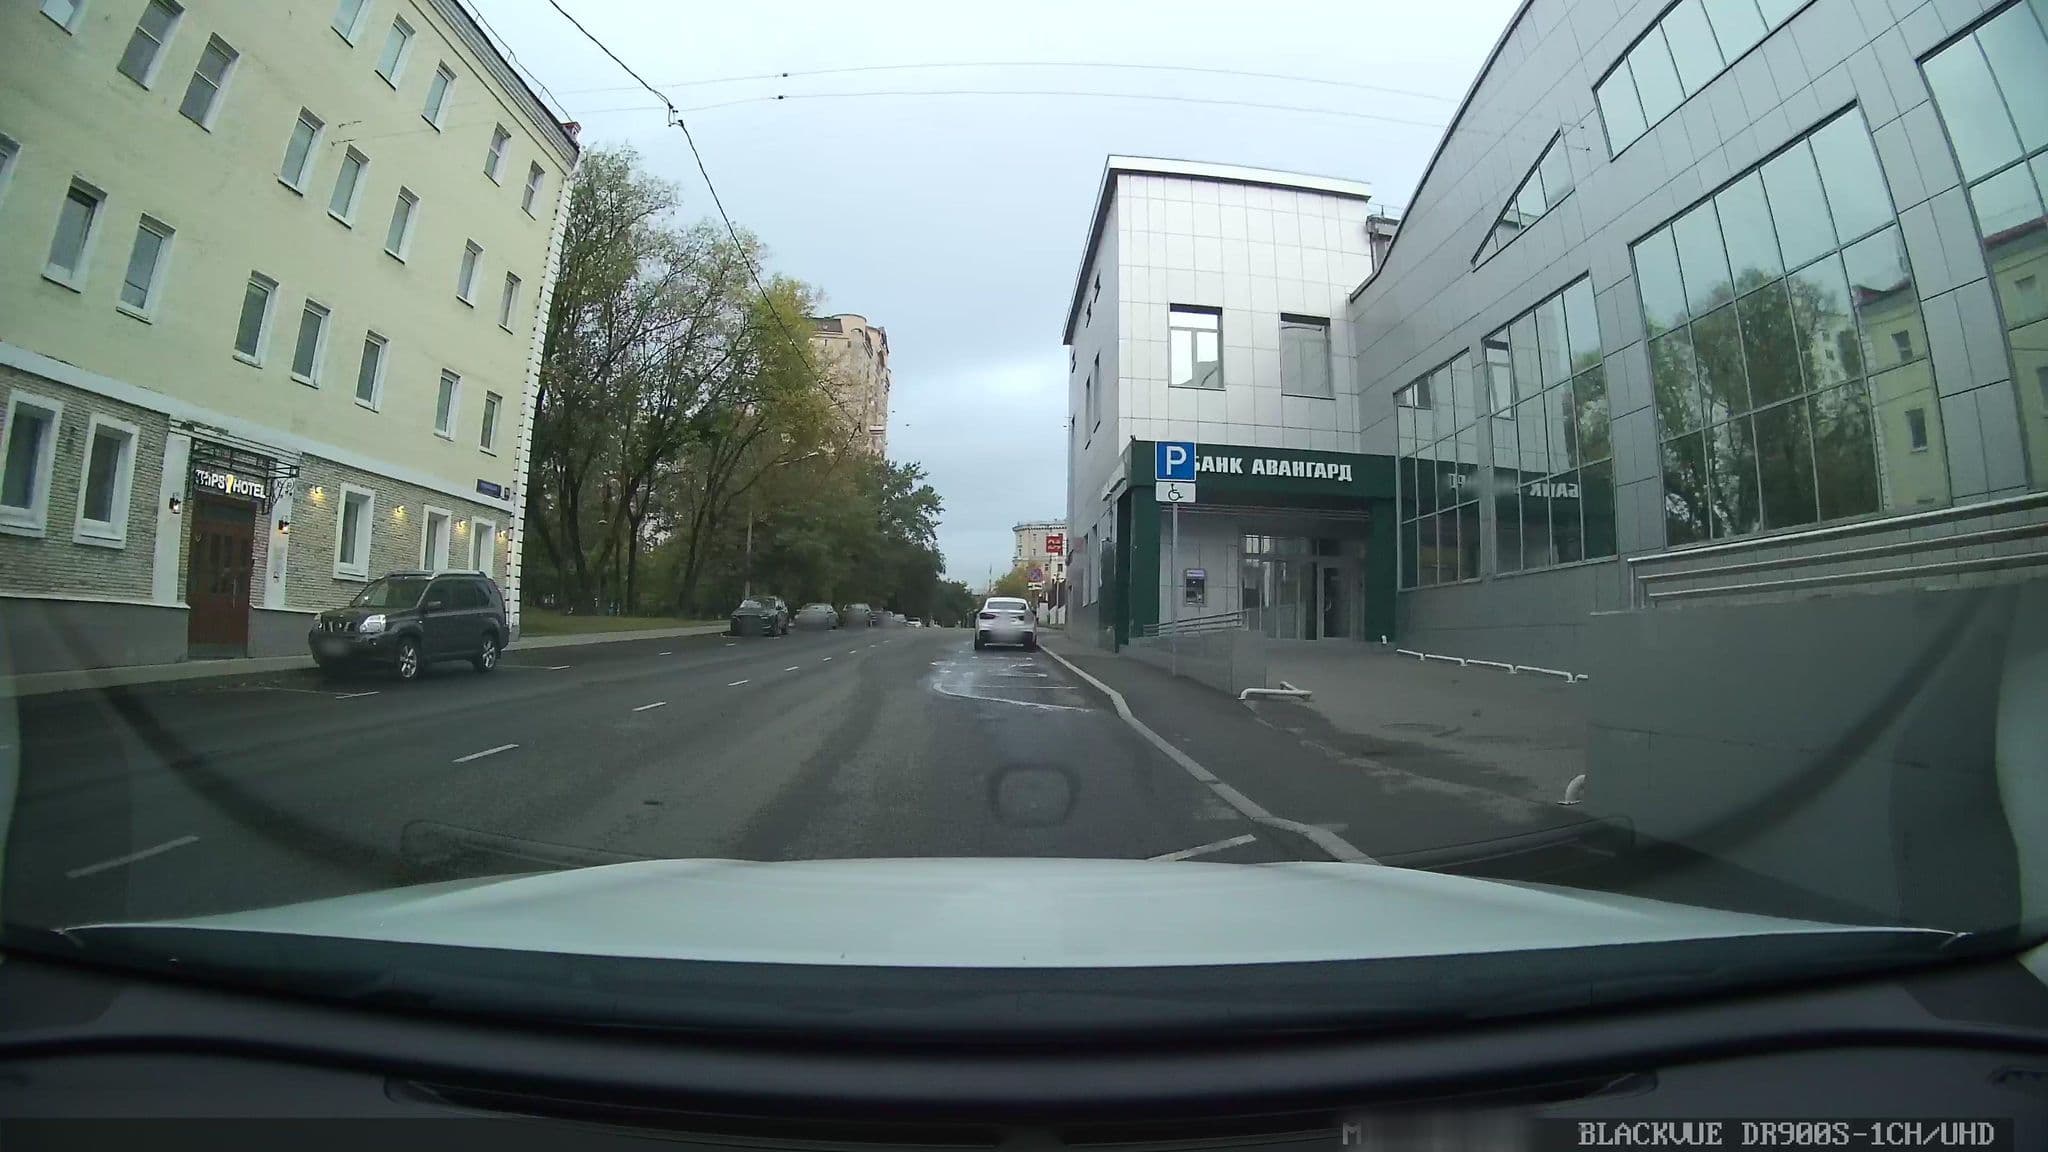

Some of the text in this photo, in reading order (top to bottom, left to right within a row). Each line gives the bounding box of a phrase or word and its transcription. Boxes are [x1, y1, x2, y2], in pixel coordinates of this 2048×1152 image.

[1166, 446, 1187, 476] P
[1252, 459, 1352, 482] АВАНГАРД
[232, 478, 266, 498] HOTEL
